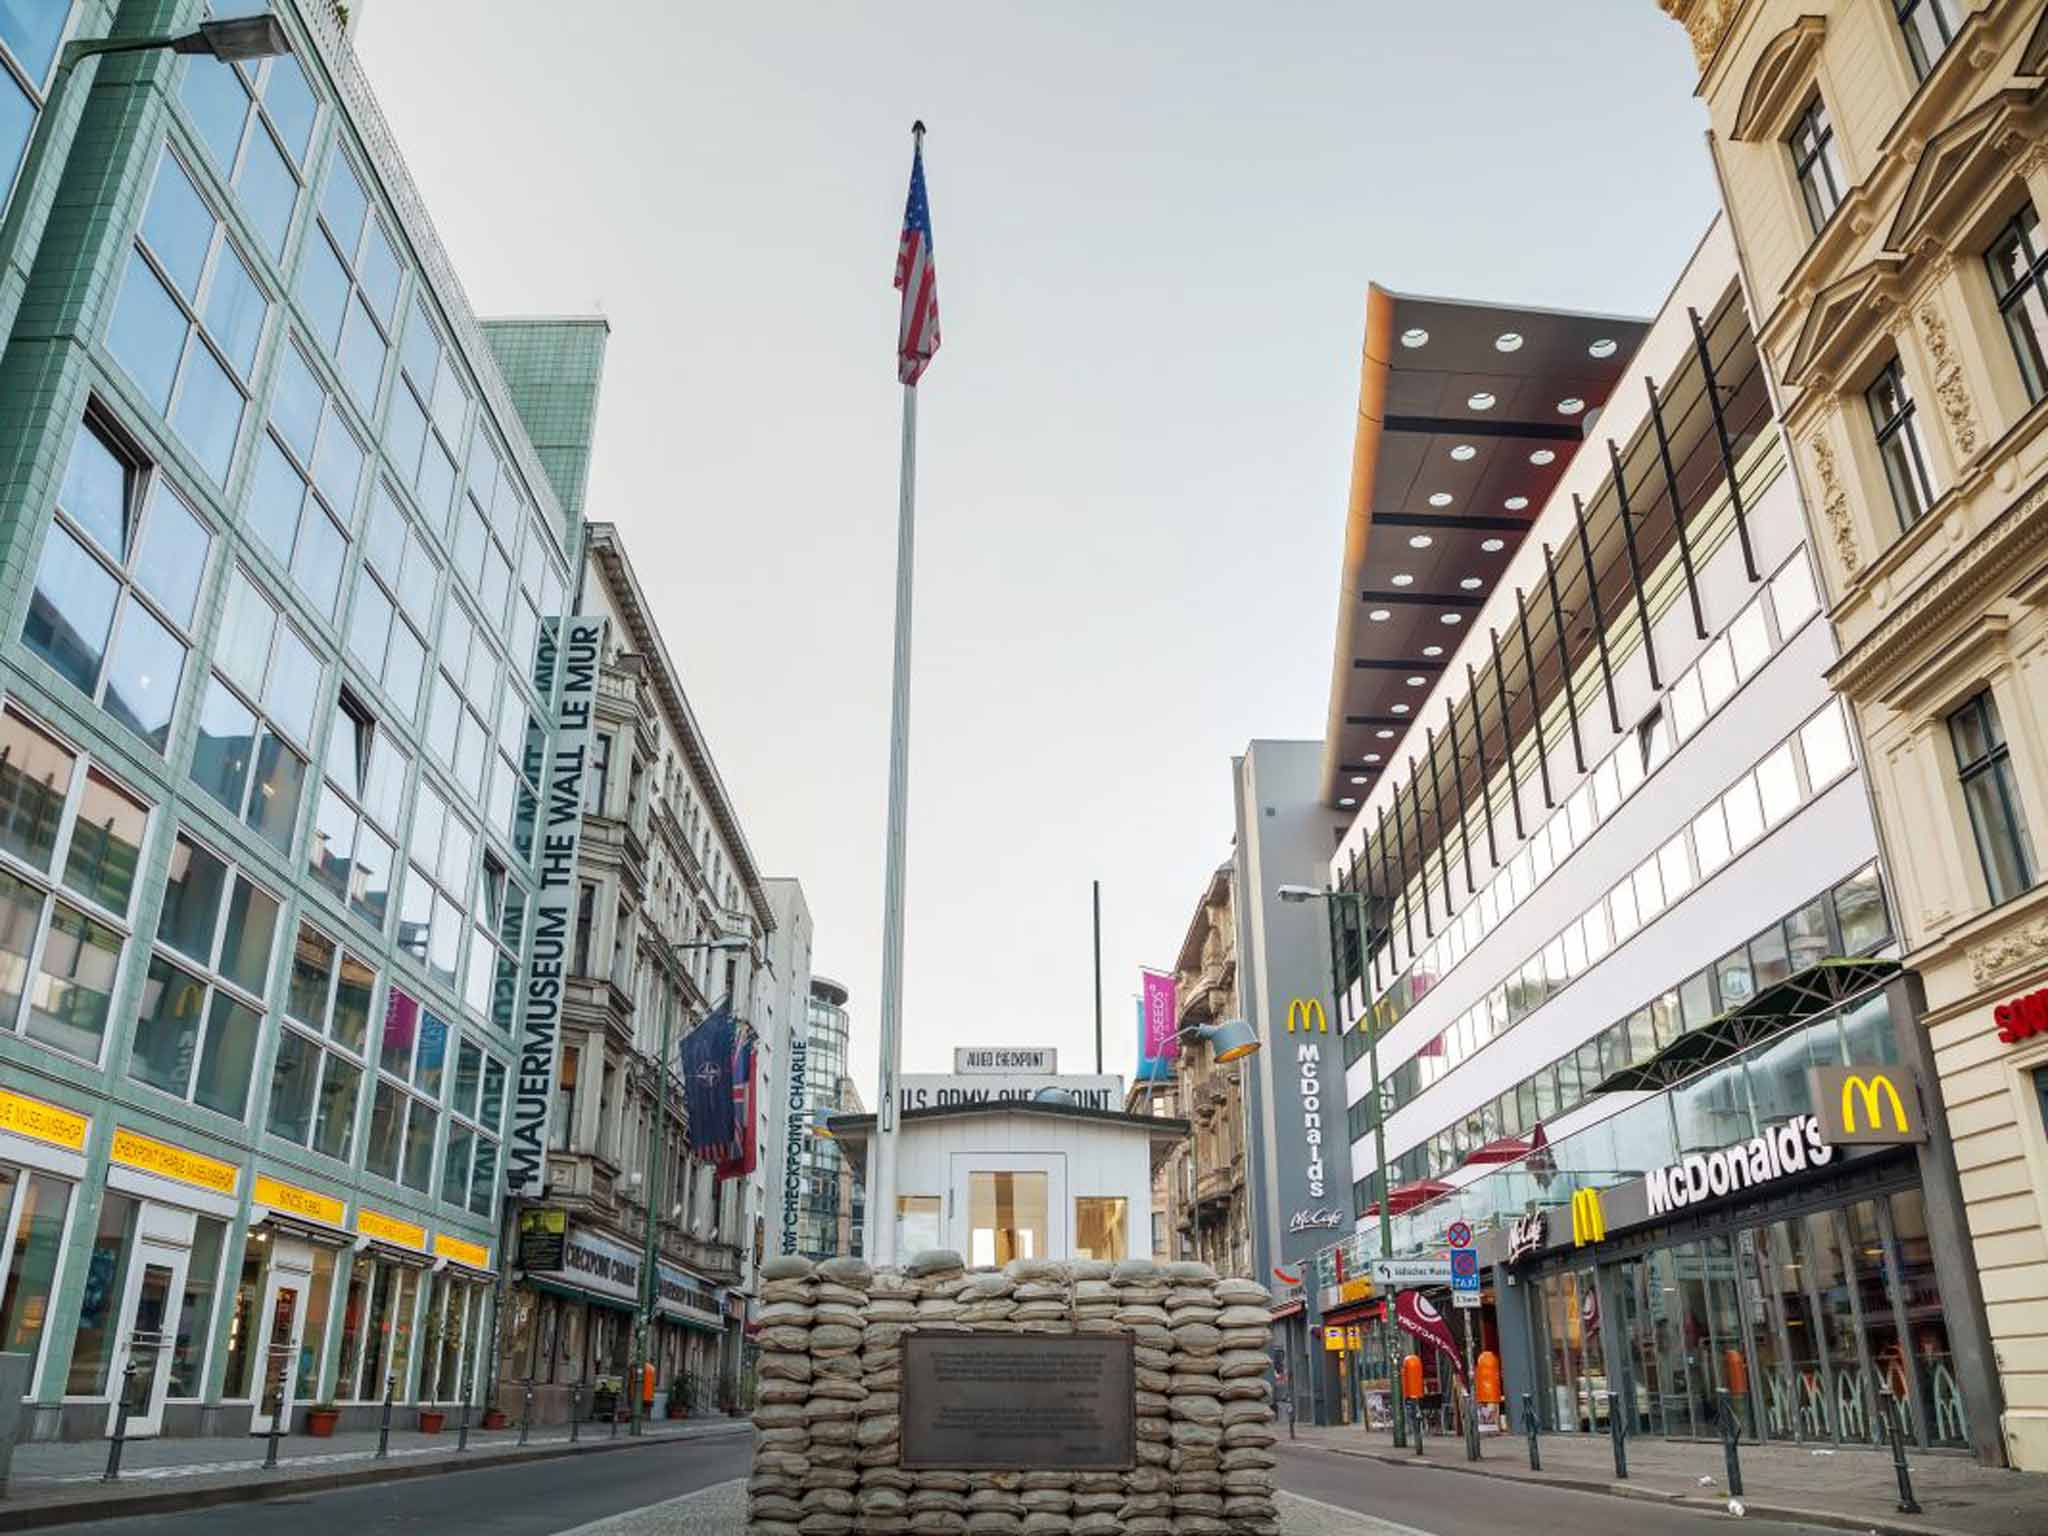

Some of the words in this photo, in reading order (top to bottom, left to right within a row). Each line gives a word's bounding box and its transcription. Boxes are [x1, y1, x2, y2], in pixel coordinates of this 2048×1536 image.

[565, 625, 599, 692] MUR
[560, 700, 590, 730] LE
[547, 744, 585, 826] WALL
[539, 834, 575, 890] THE
[509, 907, 567, 1183] MAUERMUSEUM
[790, 1041, 807, 1110] CHARLIE
[1645, 1114, 1833, 1216] McDonald's
